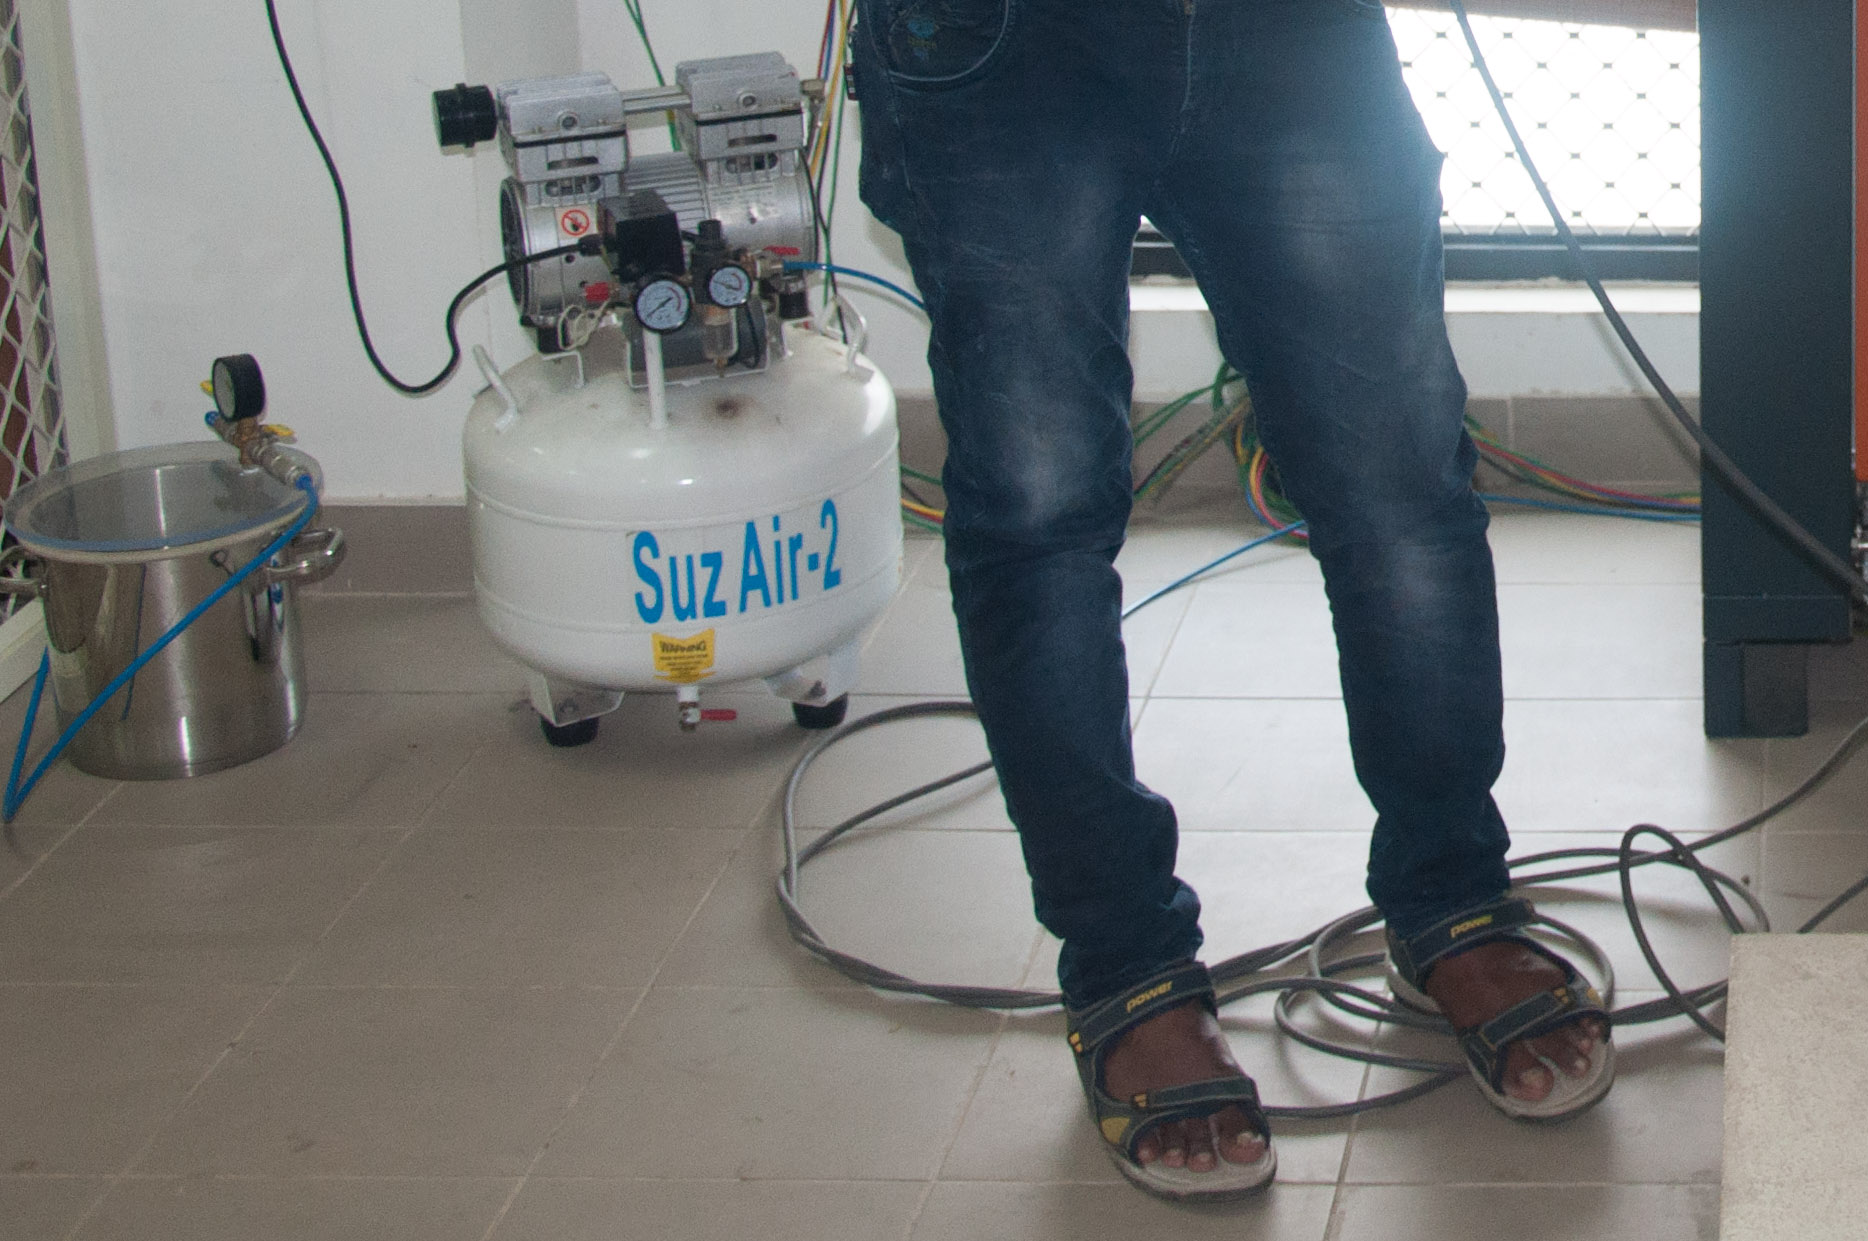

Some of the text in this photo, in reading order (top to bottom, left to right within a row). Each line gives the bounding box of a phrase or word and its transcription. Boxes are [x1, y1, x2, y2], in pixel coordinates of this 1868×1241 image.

[633, 498, 842, 624] Suz Air-2
[1126, 980, 1173, 1014] power
